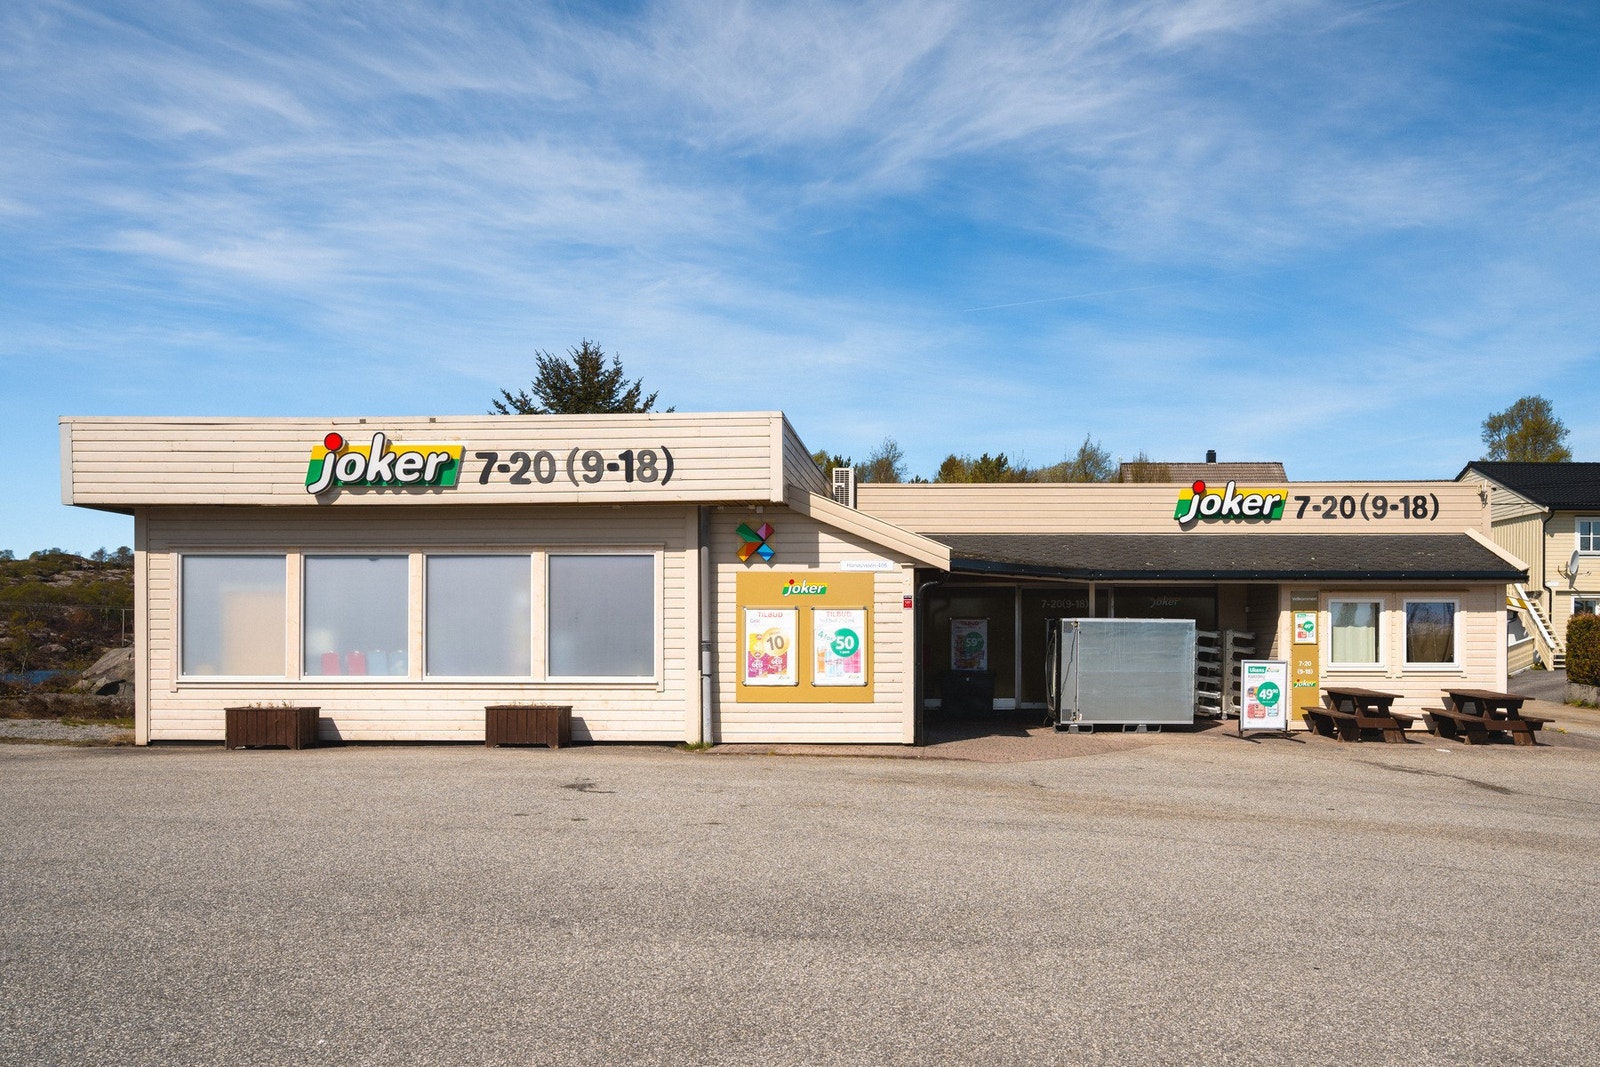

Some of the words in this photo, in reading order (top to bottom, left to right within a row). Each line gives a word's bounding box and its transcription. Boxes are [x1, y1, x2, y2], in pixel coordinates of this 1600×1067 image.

[306, 432, 452, 495] joker
[475, 451, 557, 485] 7-20
[566, 445, 675, 487] (9-18)
[1179, 480, 1281, 524] joker
[1294, 495, 1356, 520] 7-20
[1360, 492, 1440, 522] (9-18)
[784, 579, 825, 597] joker
[766, 635, 785, 651] 10
[835, 636, 855, 650] 50
